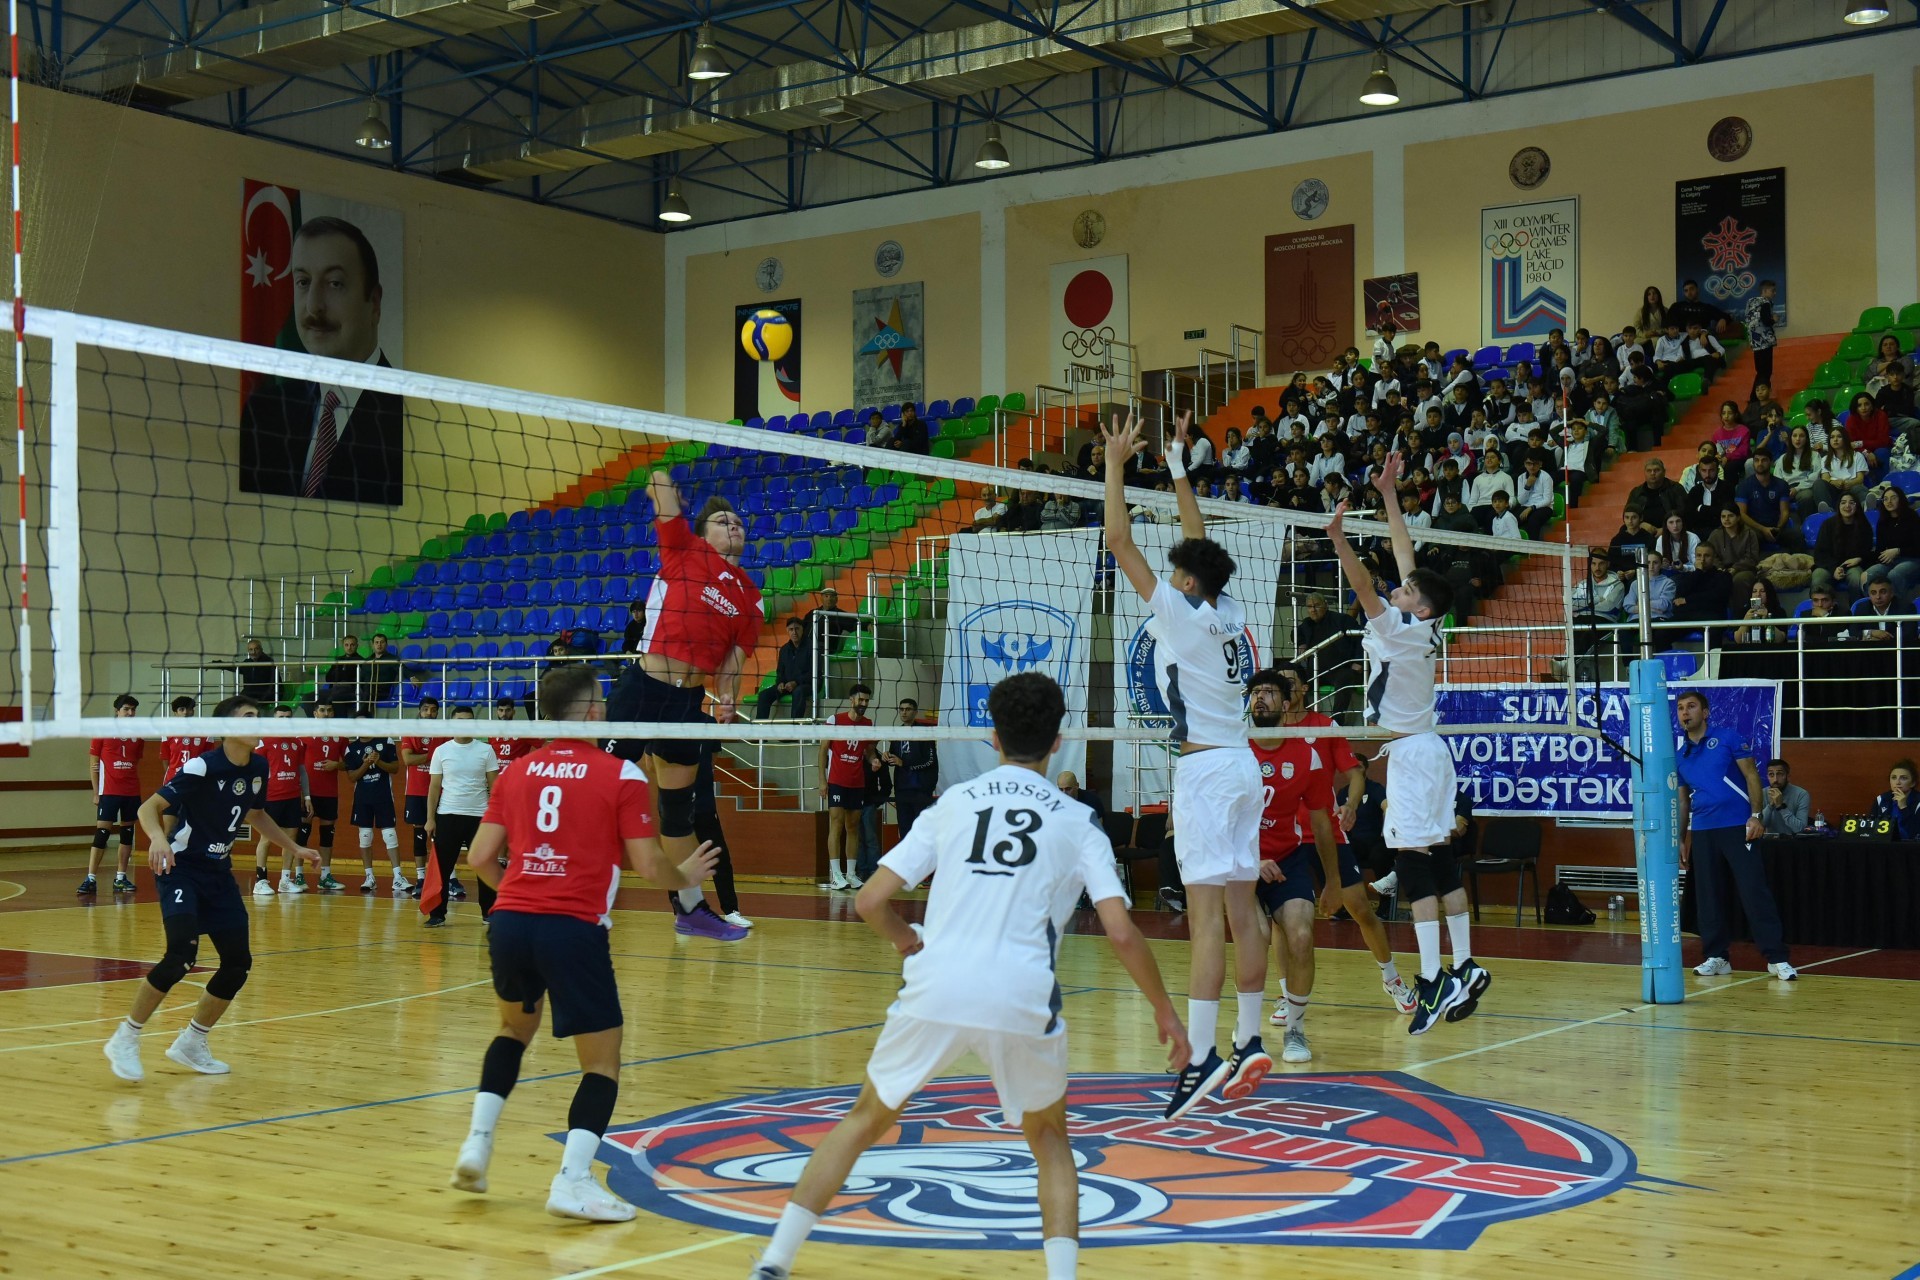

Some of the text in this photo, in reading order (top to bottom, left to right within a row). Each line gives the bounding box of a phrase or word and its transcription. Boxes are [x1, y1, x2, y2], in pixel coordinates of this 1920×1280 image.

[1685, 191, 1701, 199] Calgary
[1693, 184, 1711, 192] Together
[1494, 213, 1560, 230] XIII OLYMPIC
[1529, 223, 1571, 238] WINTER
[1273, 244, 1296, 252] MOSCOU
[1296, 241, 1320, 249] MOSCOW
[1292, 235, 1317, 244] OLYMPIAD
[1529, 235, 1567, 249] GAMES
[1526, 248, 1551, 261] LAKE
[1526, 258, 1564, 272] PLACID
[1526, 271, 1552, 284] 1980
[1222, 638, 1239, 679] 9
[322, 745, 330, 758] 9
[499, 744, 511, 756] 28
[605, 739, 617, 754] 5
[1447, 735, 1613, 763] VOLEYBOL
[284, 754, 291, 767] 4
[526, 761, 588, 780] MARKO
[1492, 776, 1634, 804] DƏSTƏK
[536, 785, 563, 833] 8
[227, 805, 242, 832] 2
[1844, 819, 1857, 833] 8
[1869, 820, 1875, 828] 1
[1877, 820, 1890, 834] 3
[964, 806, 1043, 868] 13
[174, 888, 184, 904] 2
[1651, 901, 1659, 935] EUROPEAN
[1670, 878, 1680, 944] Baku 2015
[1640, 910, 1649, 943] Baku
